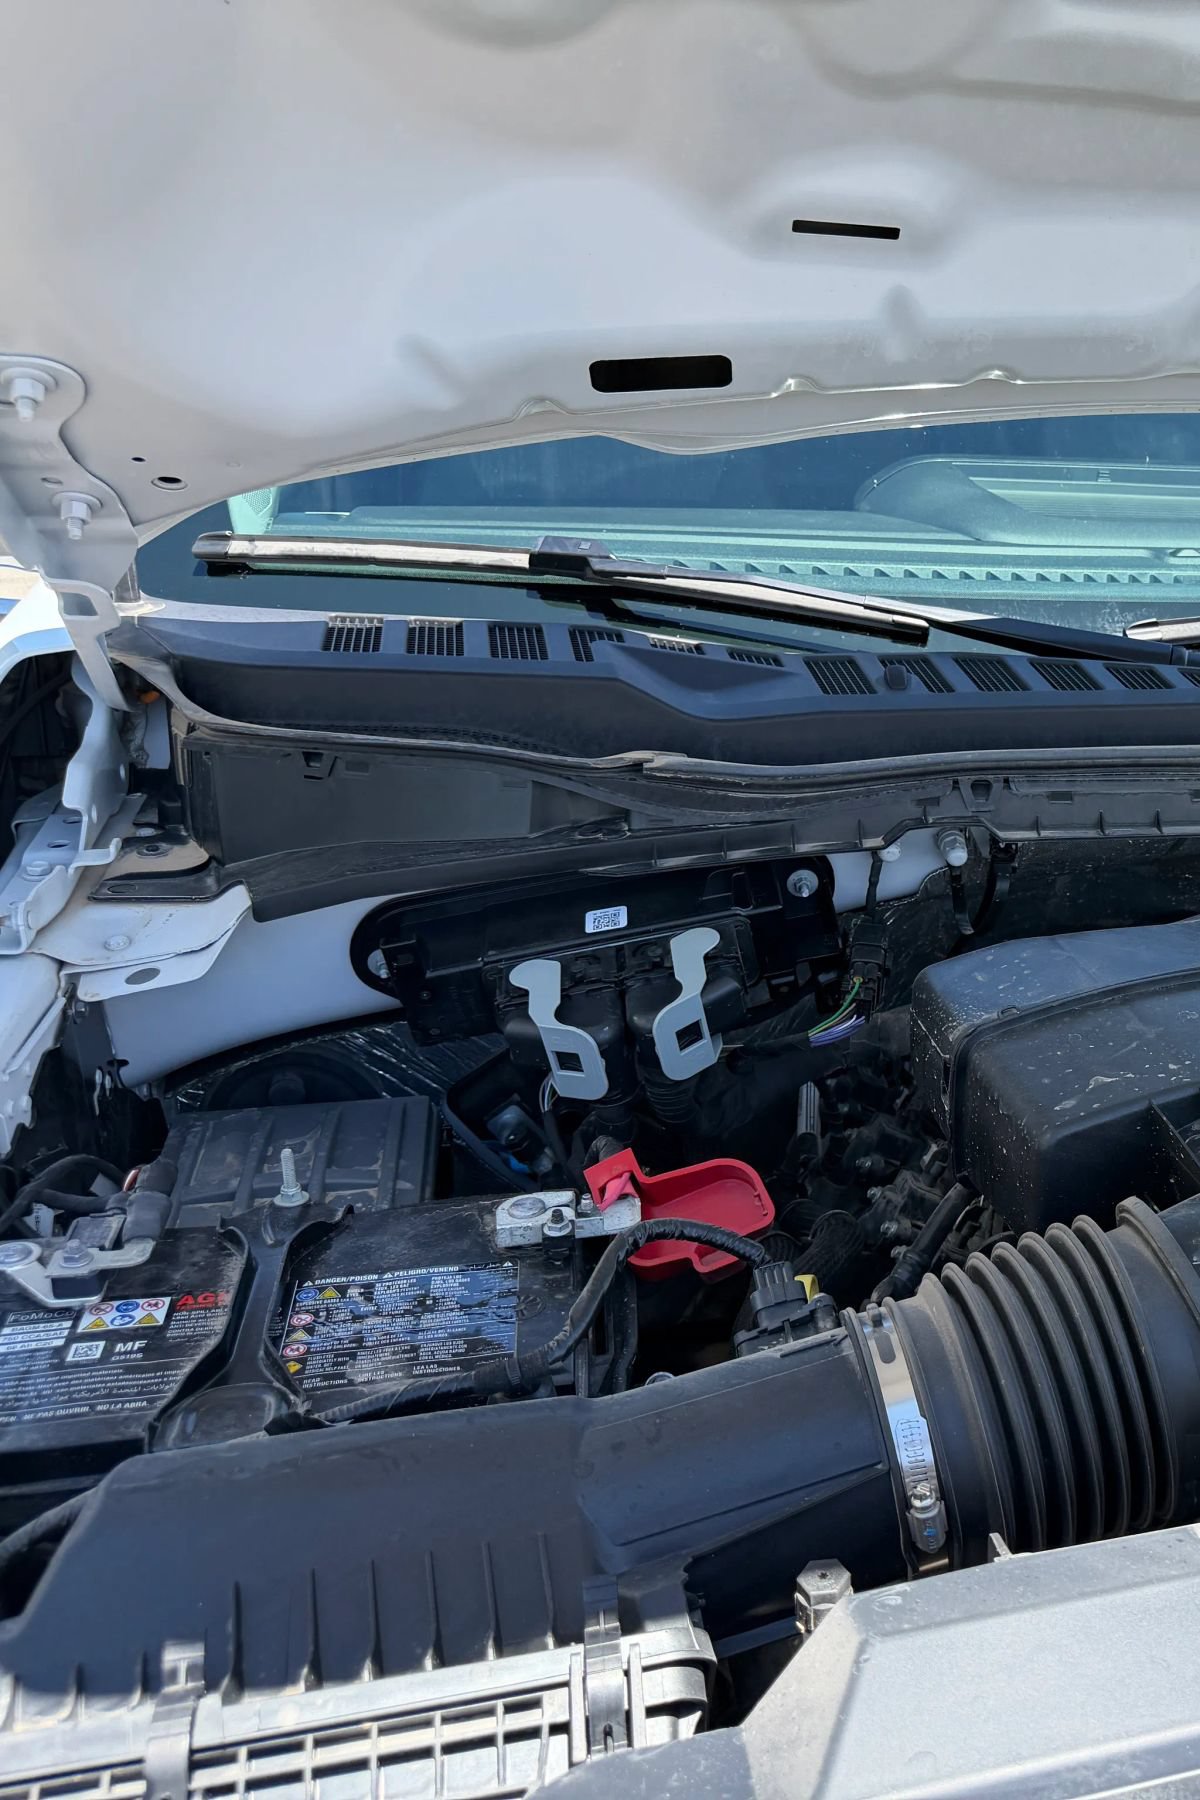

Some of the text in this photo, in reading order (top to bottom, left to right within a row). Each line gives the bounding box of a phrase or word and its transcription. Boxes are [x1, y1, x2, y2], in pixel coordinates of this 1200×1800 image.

[394, 1267, 459, 1277] PELIGRO/VENENO
[315, 1275, 379, 1285] DANGER/POISON
[9, 1311, 76, 1321] FoMoCo
[114, 1341, 148, 1353] MF
[60, 1372, 91, 1380] imported
[36, 1411, 55, 1419] PAS
